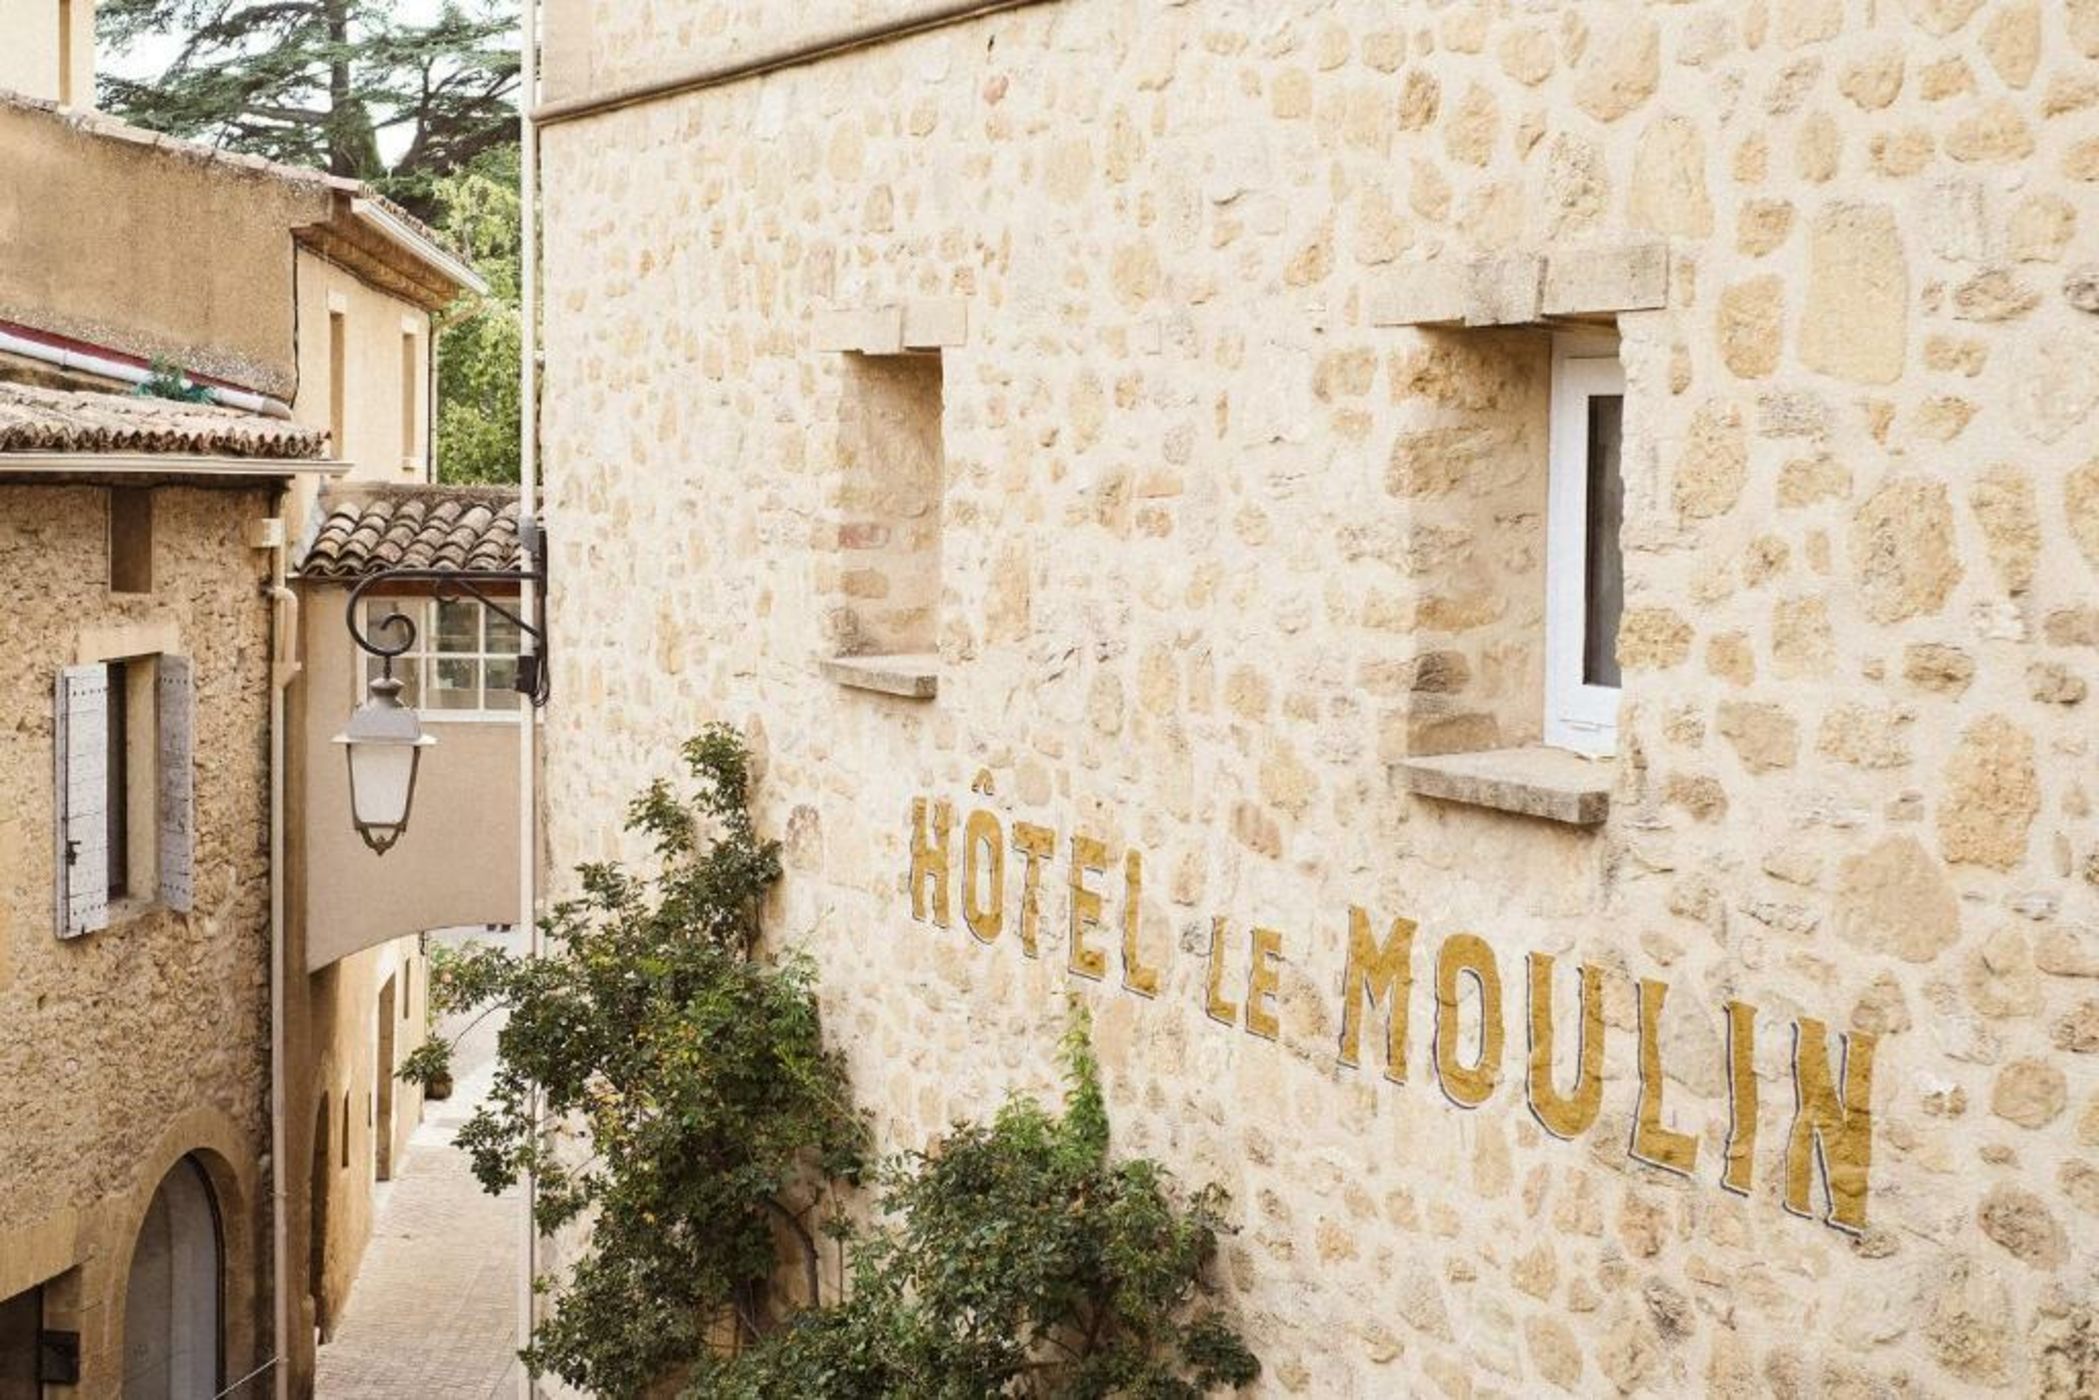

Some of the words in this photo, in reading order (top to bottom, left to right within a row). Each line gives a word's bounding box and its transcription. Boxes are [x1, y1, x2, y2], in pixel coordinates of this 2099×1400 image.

[909, 768, 1160, 999] HÔTEL
[1205, 916, 1282, 1042] LE
[1337, 904, 1876, 1236] MOULIN
